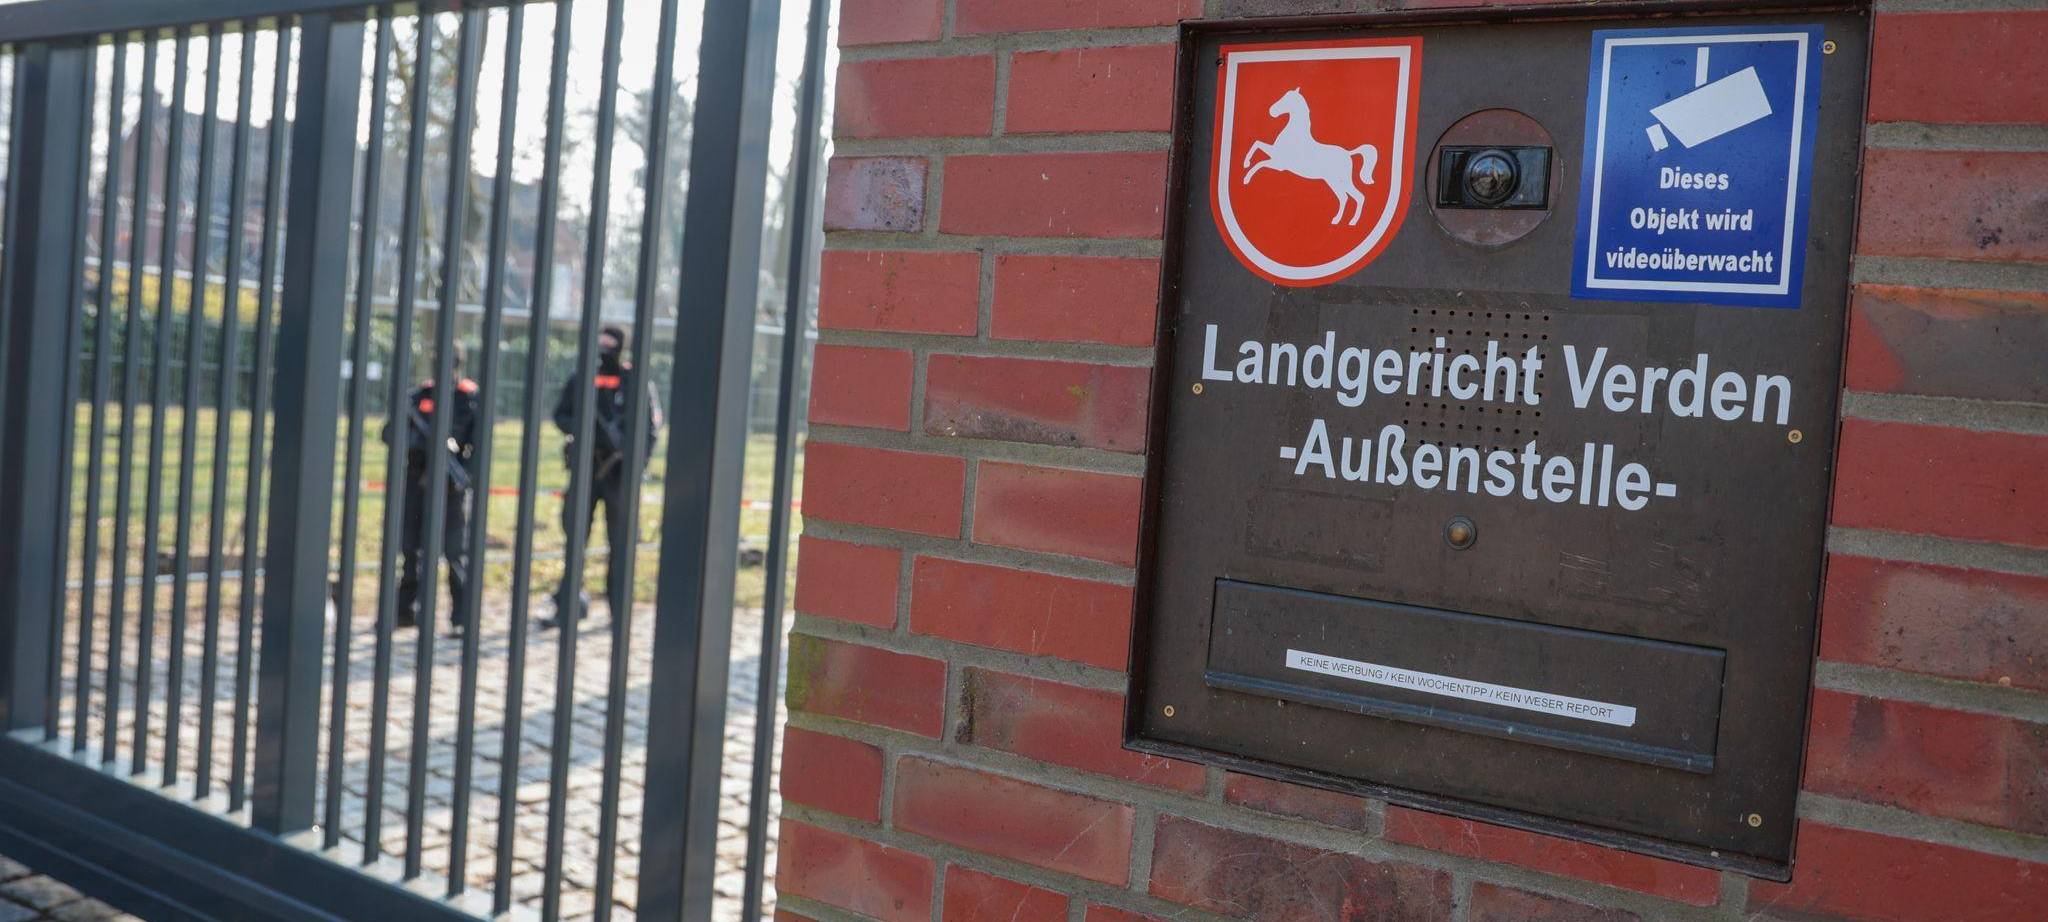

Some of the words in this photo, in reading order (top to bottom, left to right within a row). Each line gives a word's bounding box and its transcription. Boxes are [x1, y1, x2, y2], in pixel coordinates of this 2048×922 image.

[1660, 166, 1729, 190] Dieses
[1630, 207, 1699, 235] Objekt
[1705, 208, 1753, 231] wird
[1606, 246, 1774, 273] videoüberwacht
[1201, 323, 1542, 407] Landgericht
[1563, 344, 1792, 426] Verden
[1279, 418, 1677, 511] -Außenstelle-
[1300, 656, 1329, 670] KEINE
[1331, 660, 1383, 680] WERBUNG
[1384, 671, 1390, 680] /
[1390, 672, 1415, 685] KEIN
[1417, 676, 1488, 697] WOCHENTIPP
[1489, 688, 1494, 698] /
[1495, 690, 1521, 703] KEIN
[1523, 694, 1564, 711] WESER
[1566, 702, 1614, 718] REPORT
